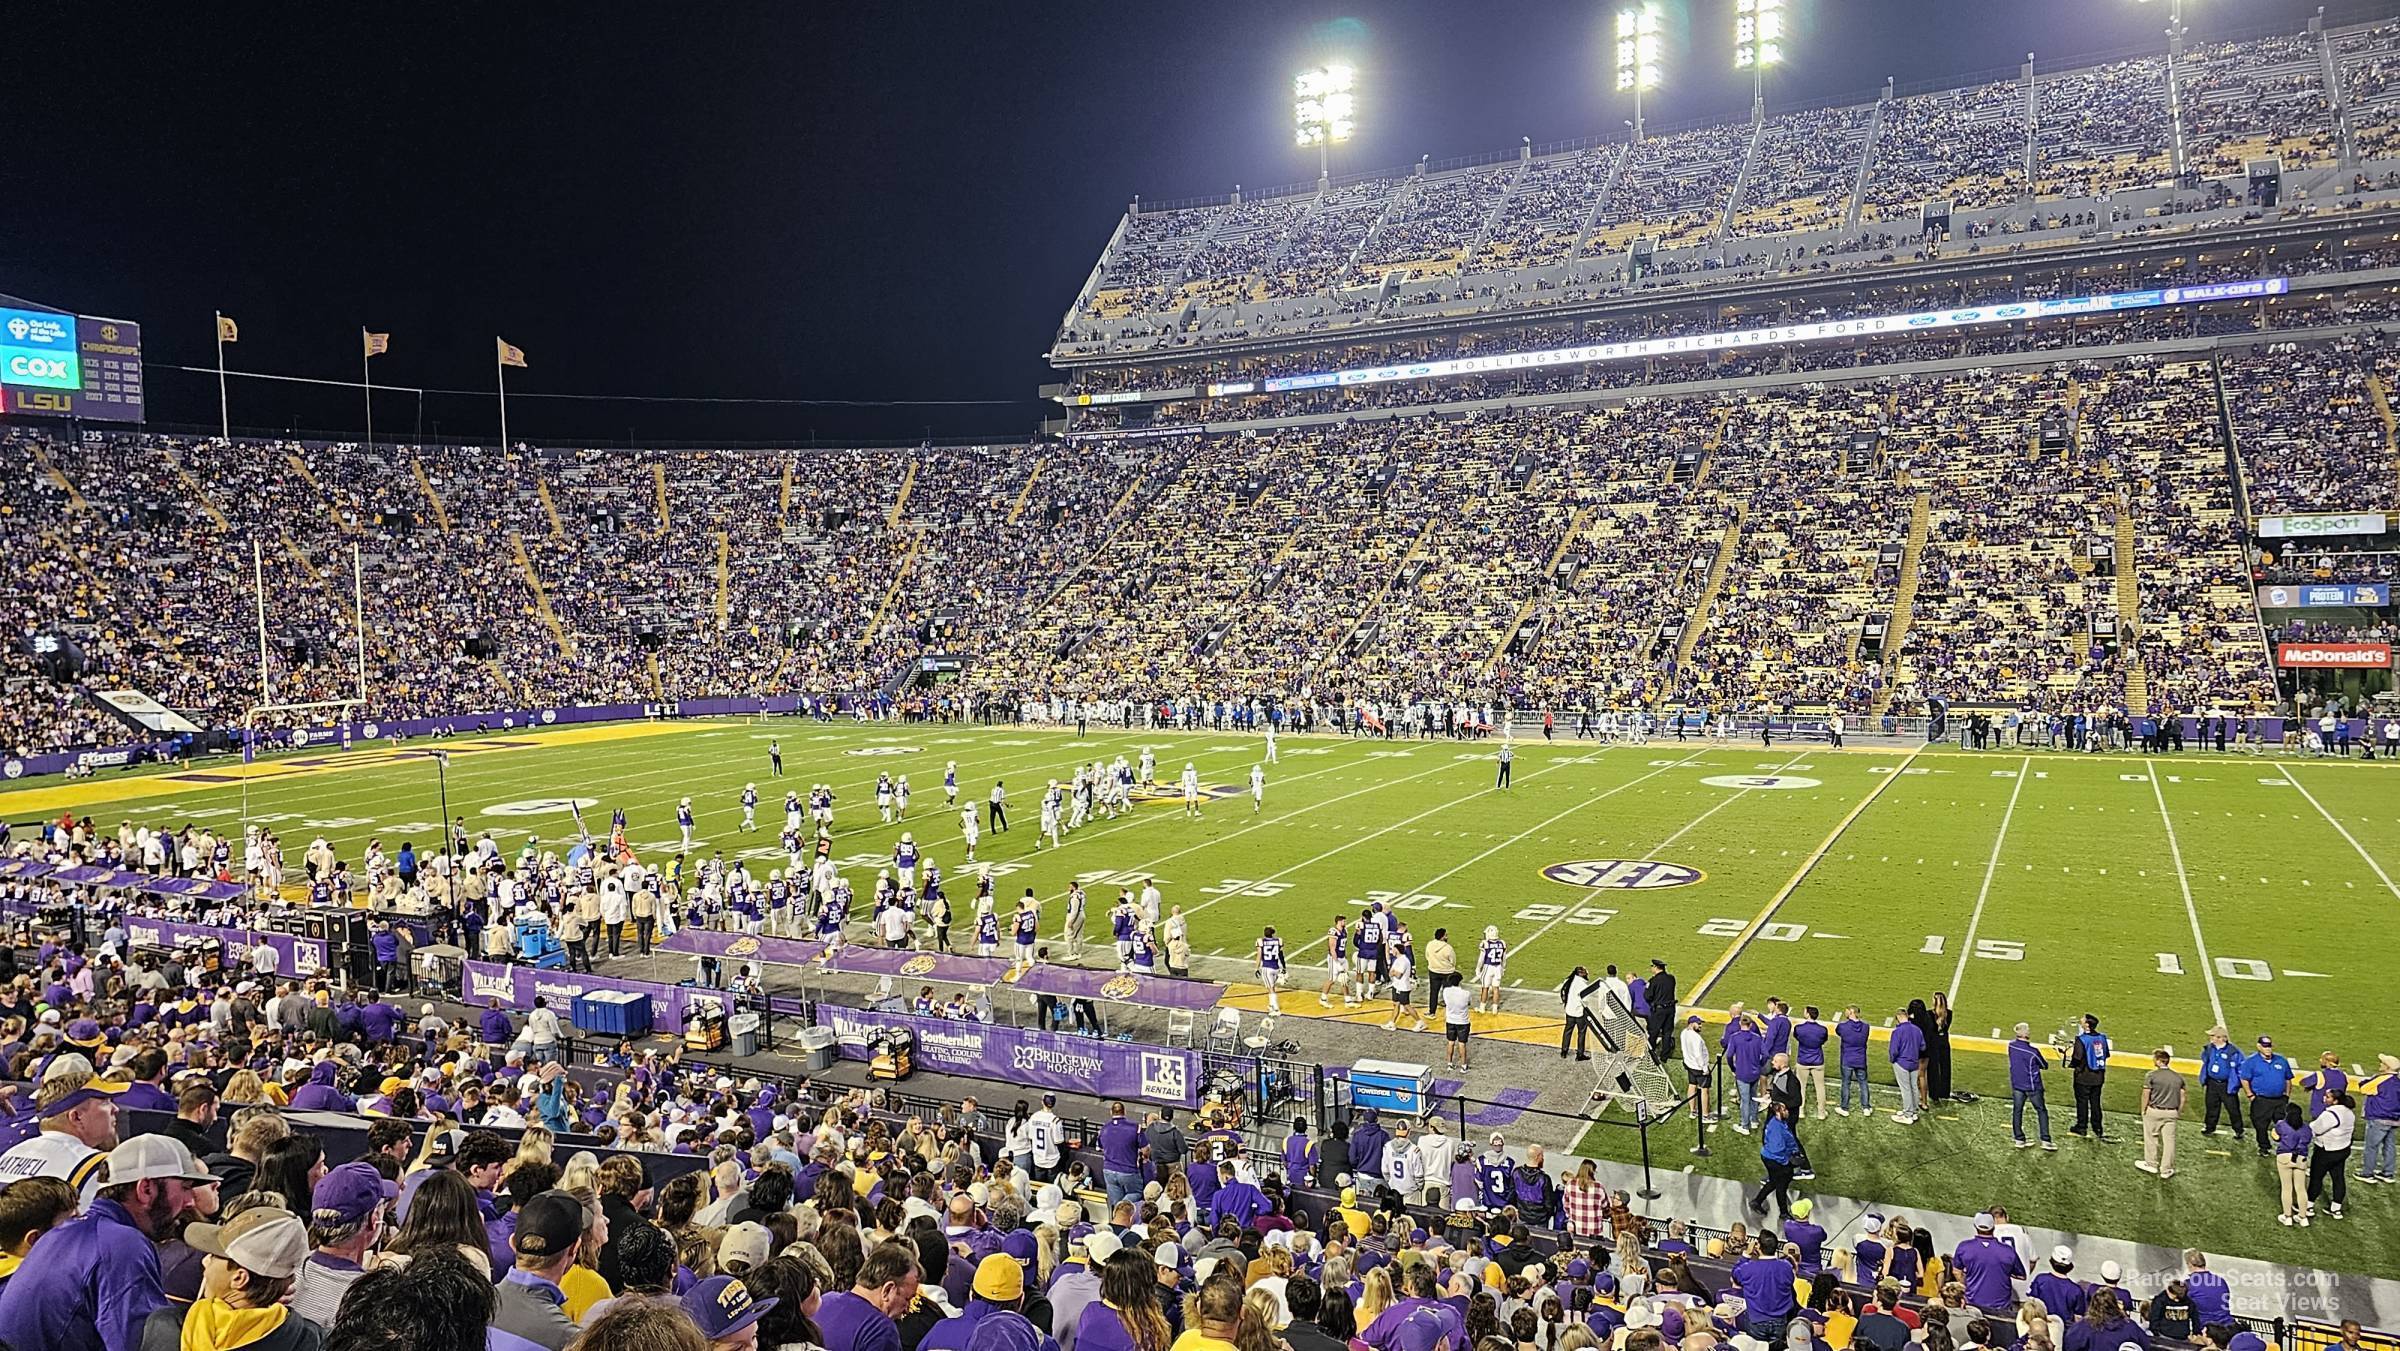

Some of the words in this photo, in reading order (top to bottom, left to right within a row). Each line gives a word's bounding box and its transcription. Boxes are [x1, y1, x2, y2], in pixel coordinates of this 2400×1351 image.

[1450, 344, 1648, 371] HOLLINGSWORTH
[1667, 328, 1797, 350] RICHARDS
[1818, 320, 1885, 335] FORD
[10, 356, 67, 379] COX
[17, 391, 71, 411] LSU
[82, 430, 103, 442] 235
[1240, 430, 1257, 438] 300
[337, 442, 358, 453] 237
[2282, 516, 2361, 533] EcoSport
[2309, 591, 2345, 601] PROTEIN
[2284, 649, 2386, 663] McDonald's
[308, 730, 335, 739] FARMS
[77, 750, 131, 767] Express
[818, 840, 830, 853] 2
[900, 843, 913, 856] 99
[1074, 869, 1157, 886] 40
[1549, 860, 1693, 888] SEC
[1199, 879, 1297, 897] 35
[1347, 890, 1448, 910] 30
[1512, 904, 1620, 926] 25
[983, 921, 996, 937] 45
[1021, 918, 1035, 933] 48
[1697, 918, 1810, 942] 20
[1364, 929, 1380, 944] 68
[1263, 945, 1280, 961] 54
[1919, 935, 2027, 961] 15
[1487, 950, 1504, 964] 43
[2154, 952, 2275, 981] 10
[919, 1029, 983, 1049] SouthernAIR
[920, 1044, 952, 1056] HEATING,
[952, 1048, 984, 1059] COOLING
[937, 1054, 972, 1065] PLUMBING
[1033, 1048, 1104, 1072] BRIDGEWAY
[1046, 1062, 1091, 1079] HOSPICE
[1145, 1056, 1182, 1087] H&E
[1145, 1085, 1182, 1097] RENTALS
[1356, 1087, 1392, 1097] POWERADE
[1035, 1128, 1046, 1150] 9
[1212, 1143, 1224, 1160] 2
[1393, 1161, 1405, 1180] 9
[1489, 1170, 1505, 1193] 3
